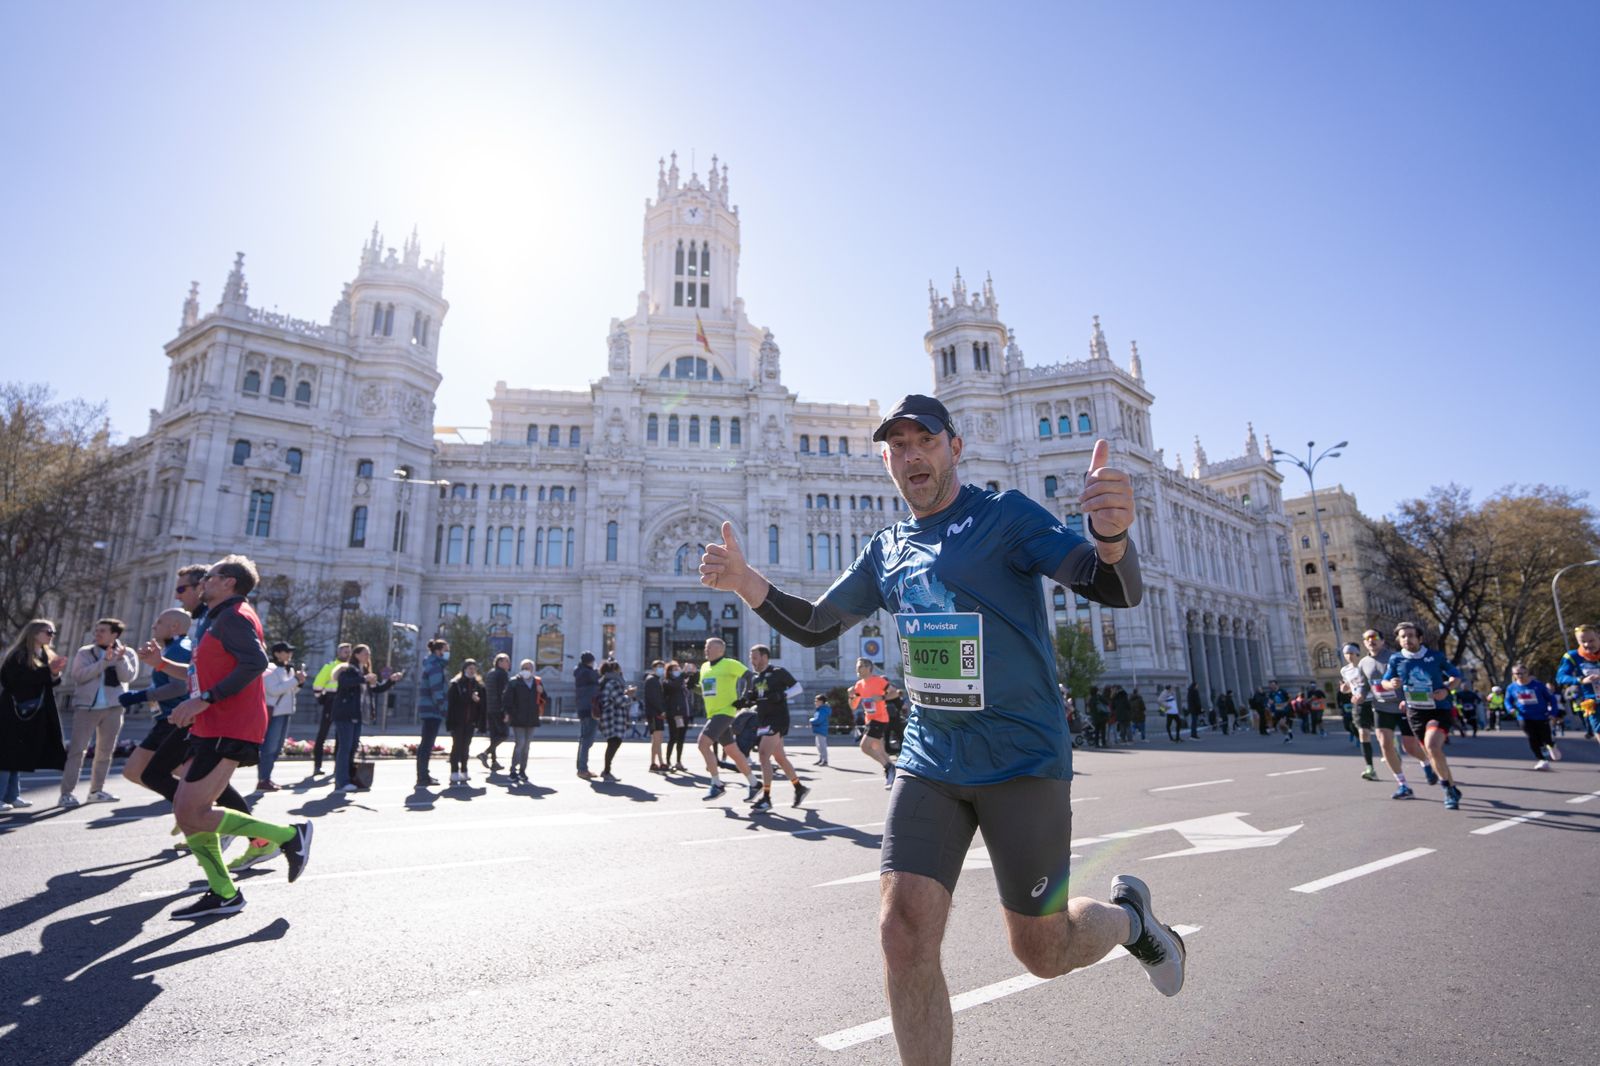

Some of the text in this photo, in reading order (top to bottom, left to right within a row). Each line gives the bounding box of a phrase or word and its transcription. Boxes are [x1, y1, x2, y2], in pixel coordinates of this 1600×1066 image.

[924, 622, 958, 630] Movistar
[914, 649, 949, 665] 4076
[923, 682, 941, 690] DAVID
